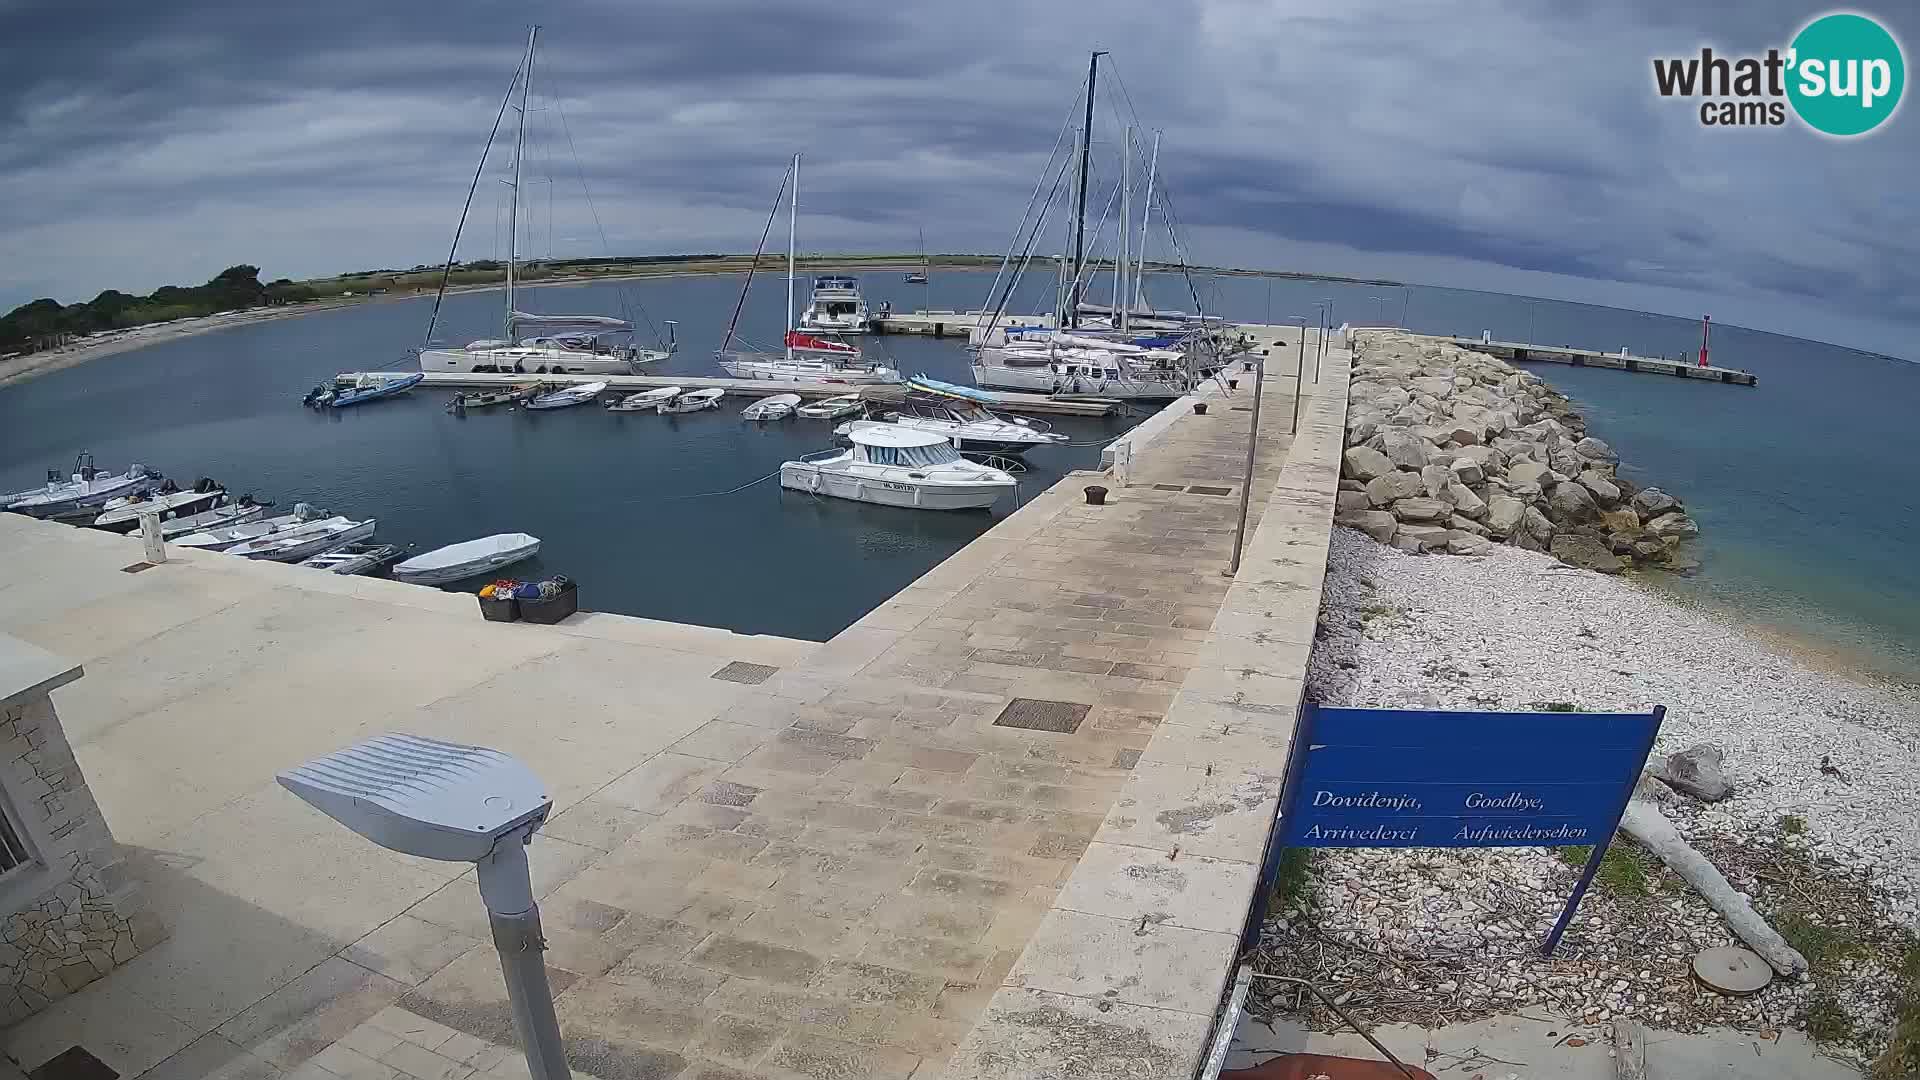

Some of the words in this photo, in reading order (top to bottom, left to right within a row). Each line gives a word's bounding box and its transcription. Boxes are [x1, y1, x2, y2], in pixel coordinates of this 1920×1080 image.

[1464, 792, 1545, 811] Goodbye,
[1303, 823, 1419, 840] Arrivederci
[1452, 823, 1588, 841] Aufwiedersehen
